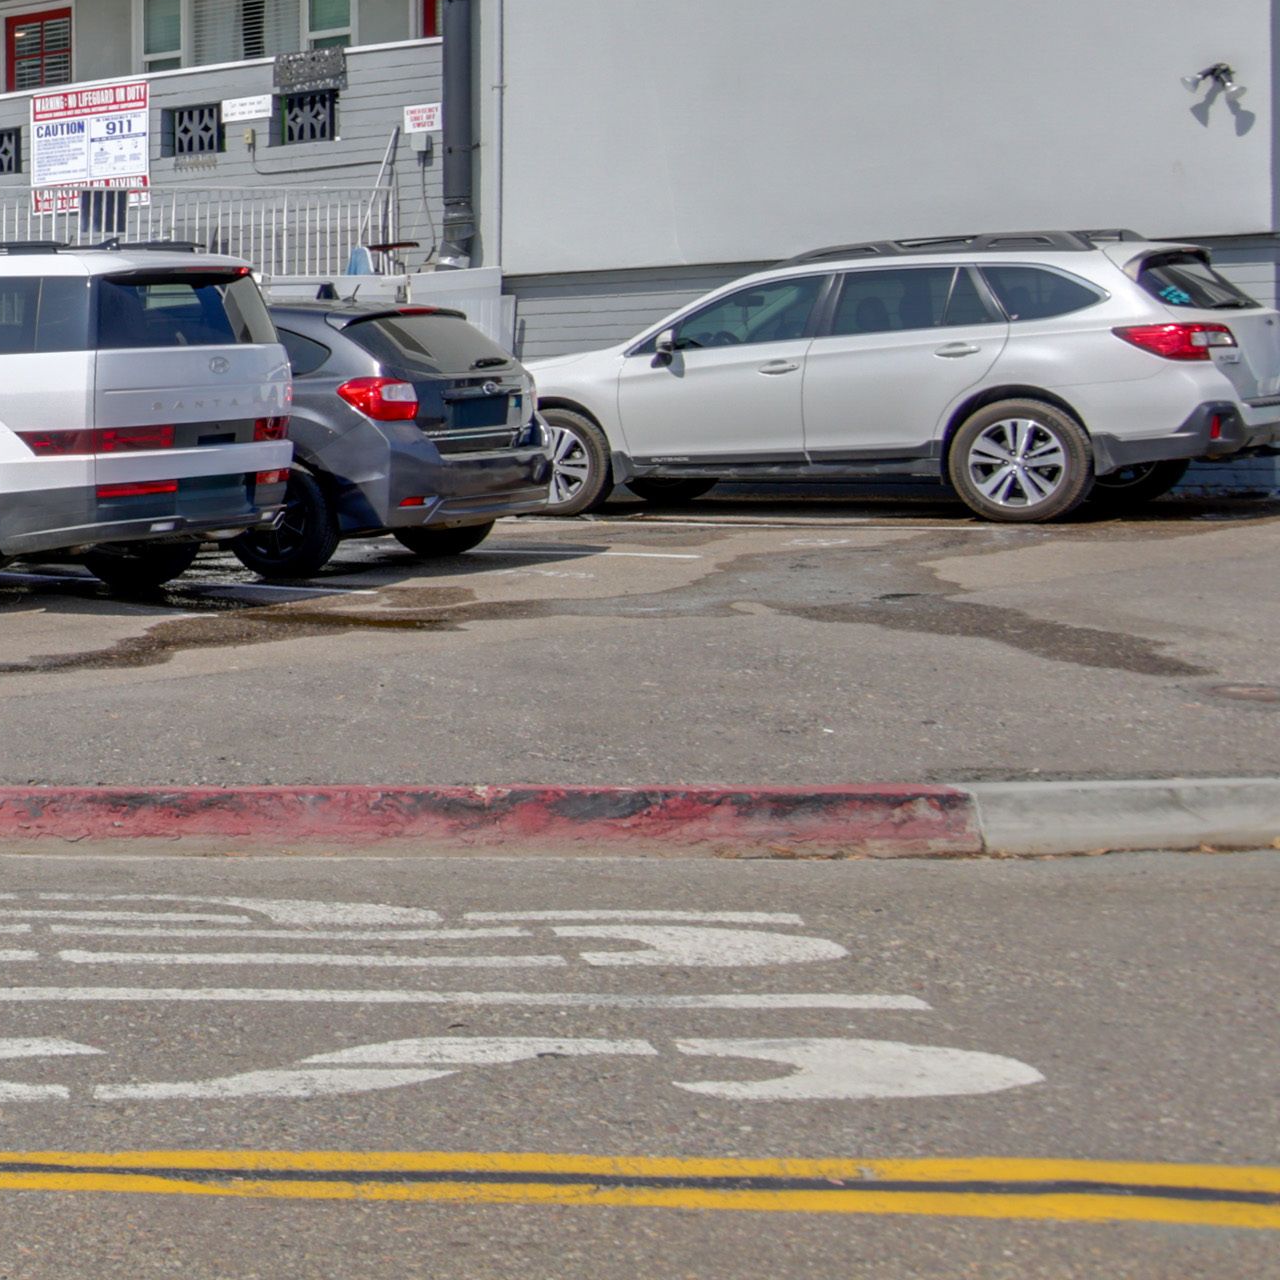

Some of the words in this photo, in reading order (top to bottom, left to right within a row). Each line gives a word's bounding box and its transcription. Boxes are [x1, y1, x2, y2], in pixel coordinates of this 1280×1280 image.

[35, 95, 67, 113] WARNING:
[68, 93, 77, 108] NO
[78, 88, 114, 107] LIFEGUARD
[115, 87, 125, 102] ON
[127, 84, 145, 101] DUTY
[37, 120, 85, 138] CAUTION
[106, 120, 132, 135] 911
[109, 176, 143, 188] DIVING
[152, 398, 238, 410] SANTA
